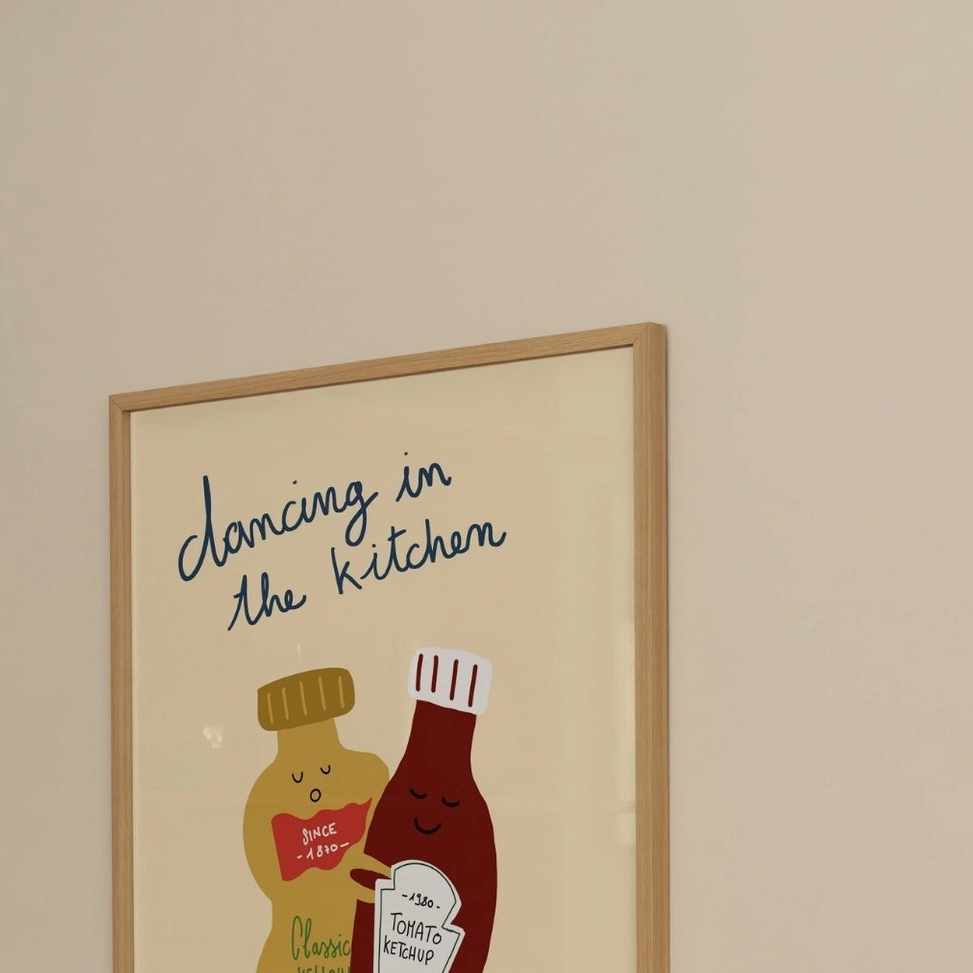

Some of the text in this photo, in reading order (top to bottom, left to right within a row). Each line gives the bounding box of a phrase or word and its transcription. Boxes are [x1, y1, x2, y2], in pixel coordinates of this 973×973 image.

[178, 452, 452, 582] dancing in
[227, 518, 507, 631] the kitchen
[302, 822, 337, 846] SINCE
[291, 915, 351, 961] Classic
[390, 912, 442, 945] TOMATO
[383, 934, 435, 966] KETCHUP
